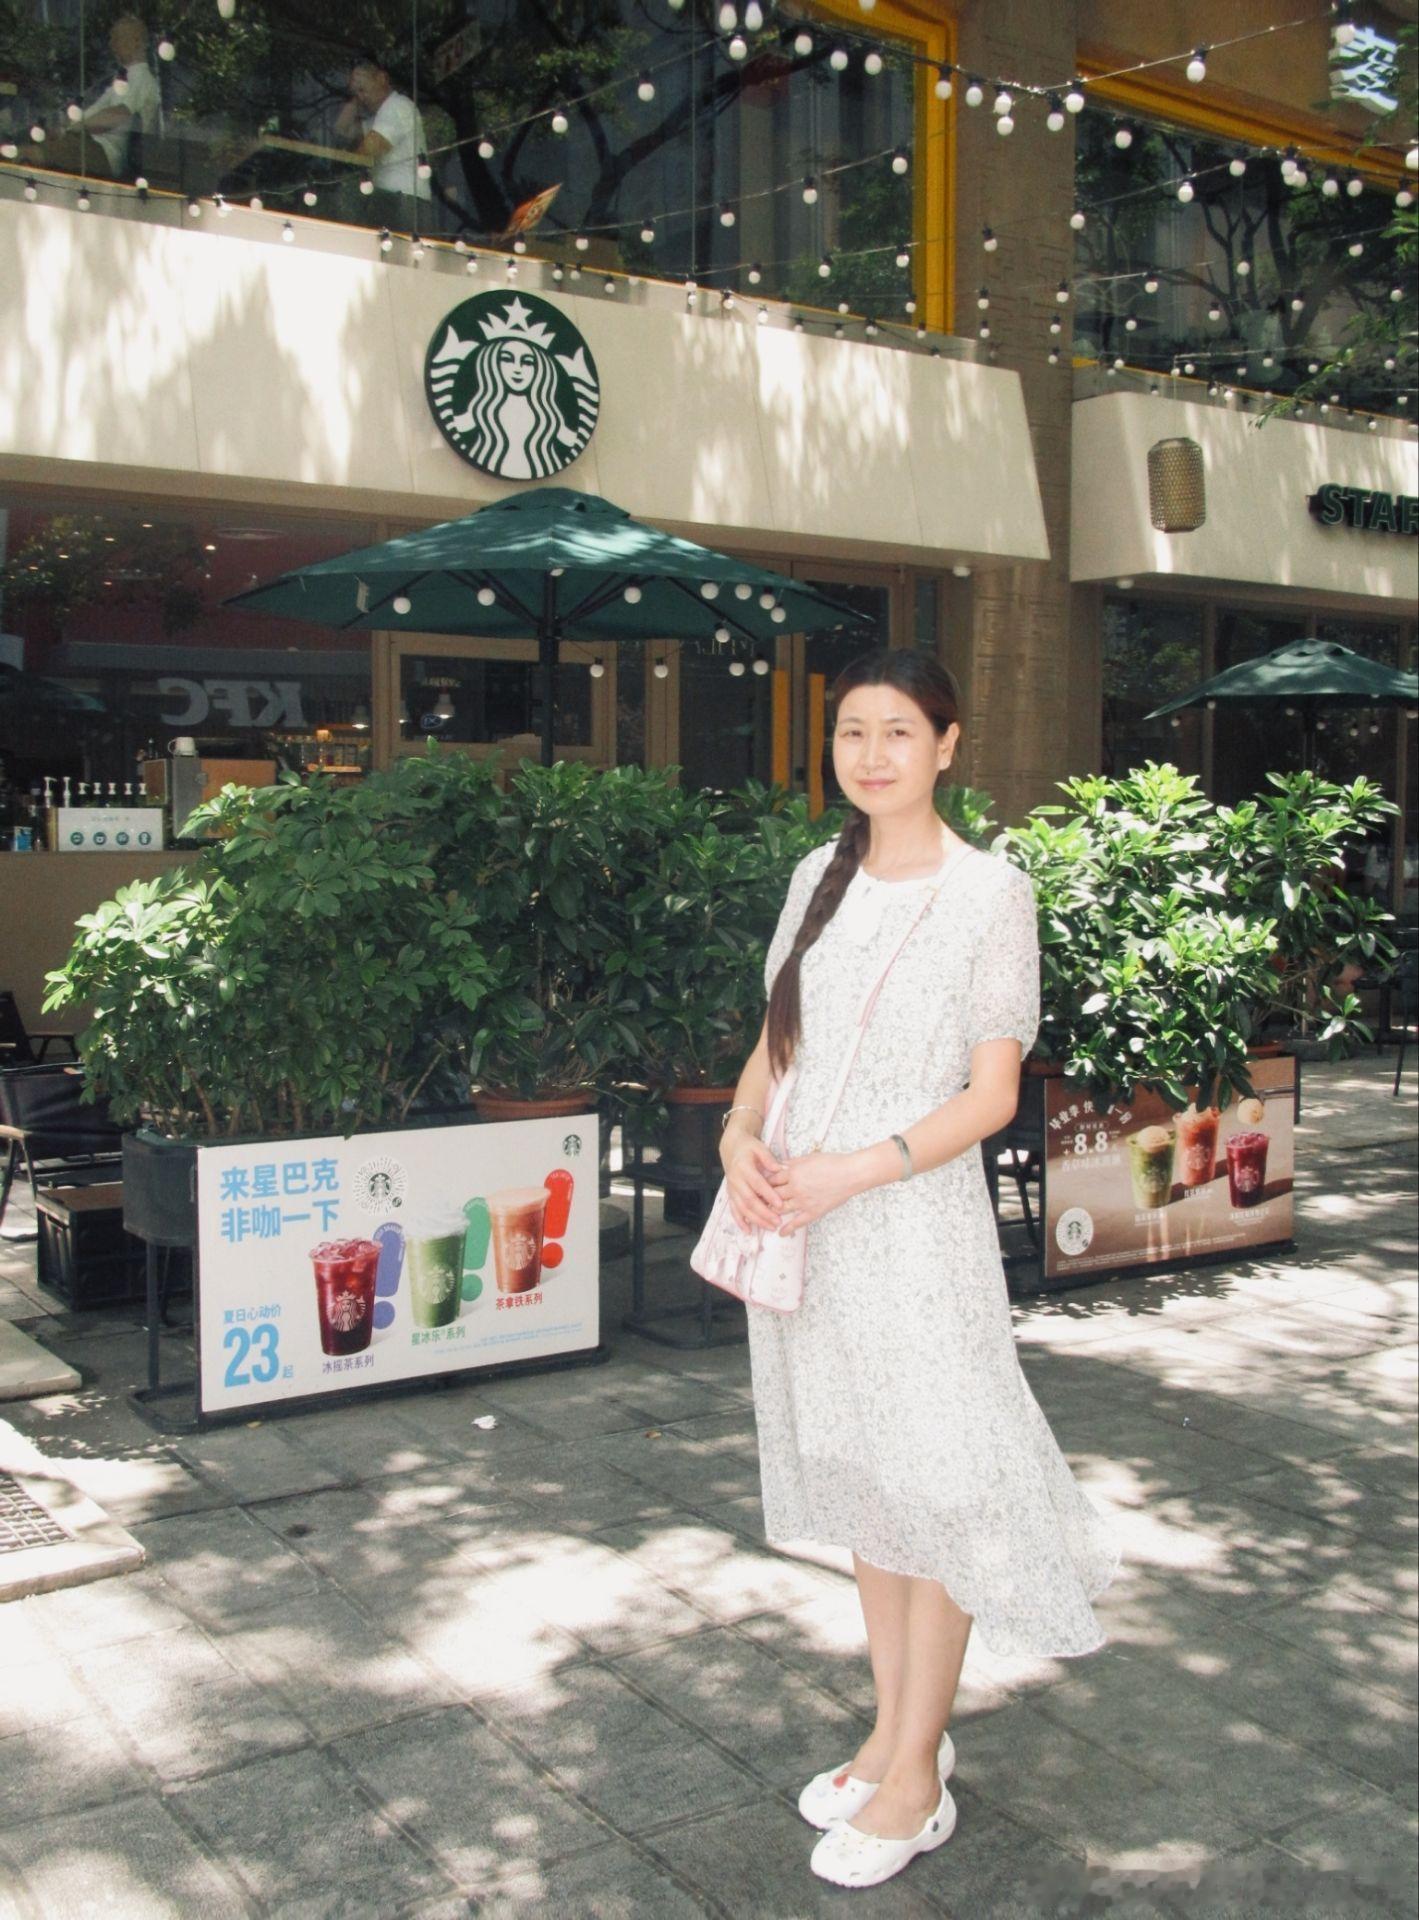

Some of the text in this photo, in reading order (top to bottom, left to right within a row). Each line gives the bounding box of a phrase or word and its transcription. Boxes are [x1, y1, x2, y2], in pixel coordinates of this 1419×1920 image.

[220, 1157, 340, 1201] 来星巴克
[220, 1199, 340, 1243] 非咖一下
[223, 1303, 282, 1324] 夏日心动价
[495, 1291, 543, 1311] 茶拿铁系列
[223, 1323, 280, 1388] 23
[321, 1354, 375, 1375] 冰摇茶系列
